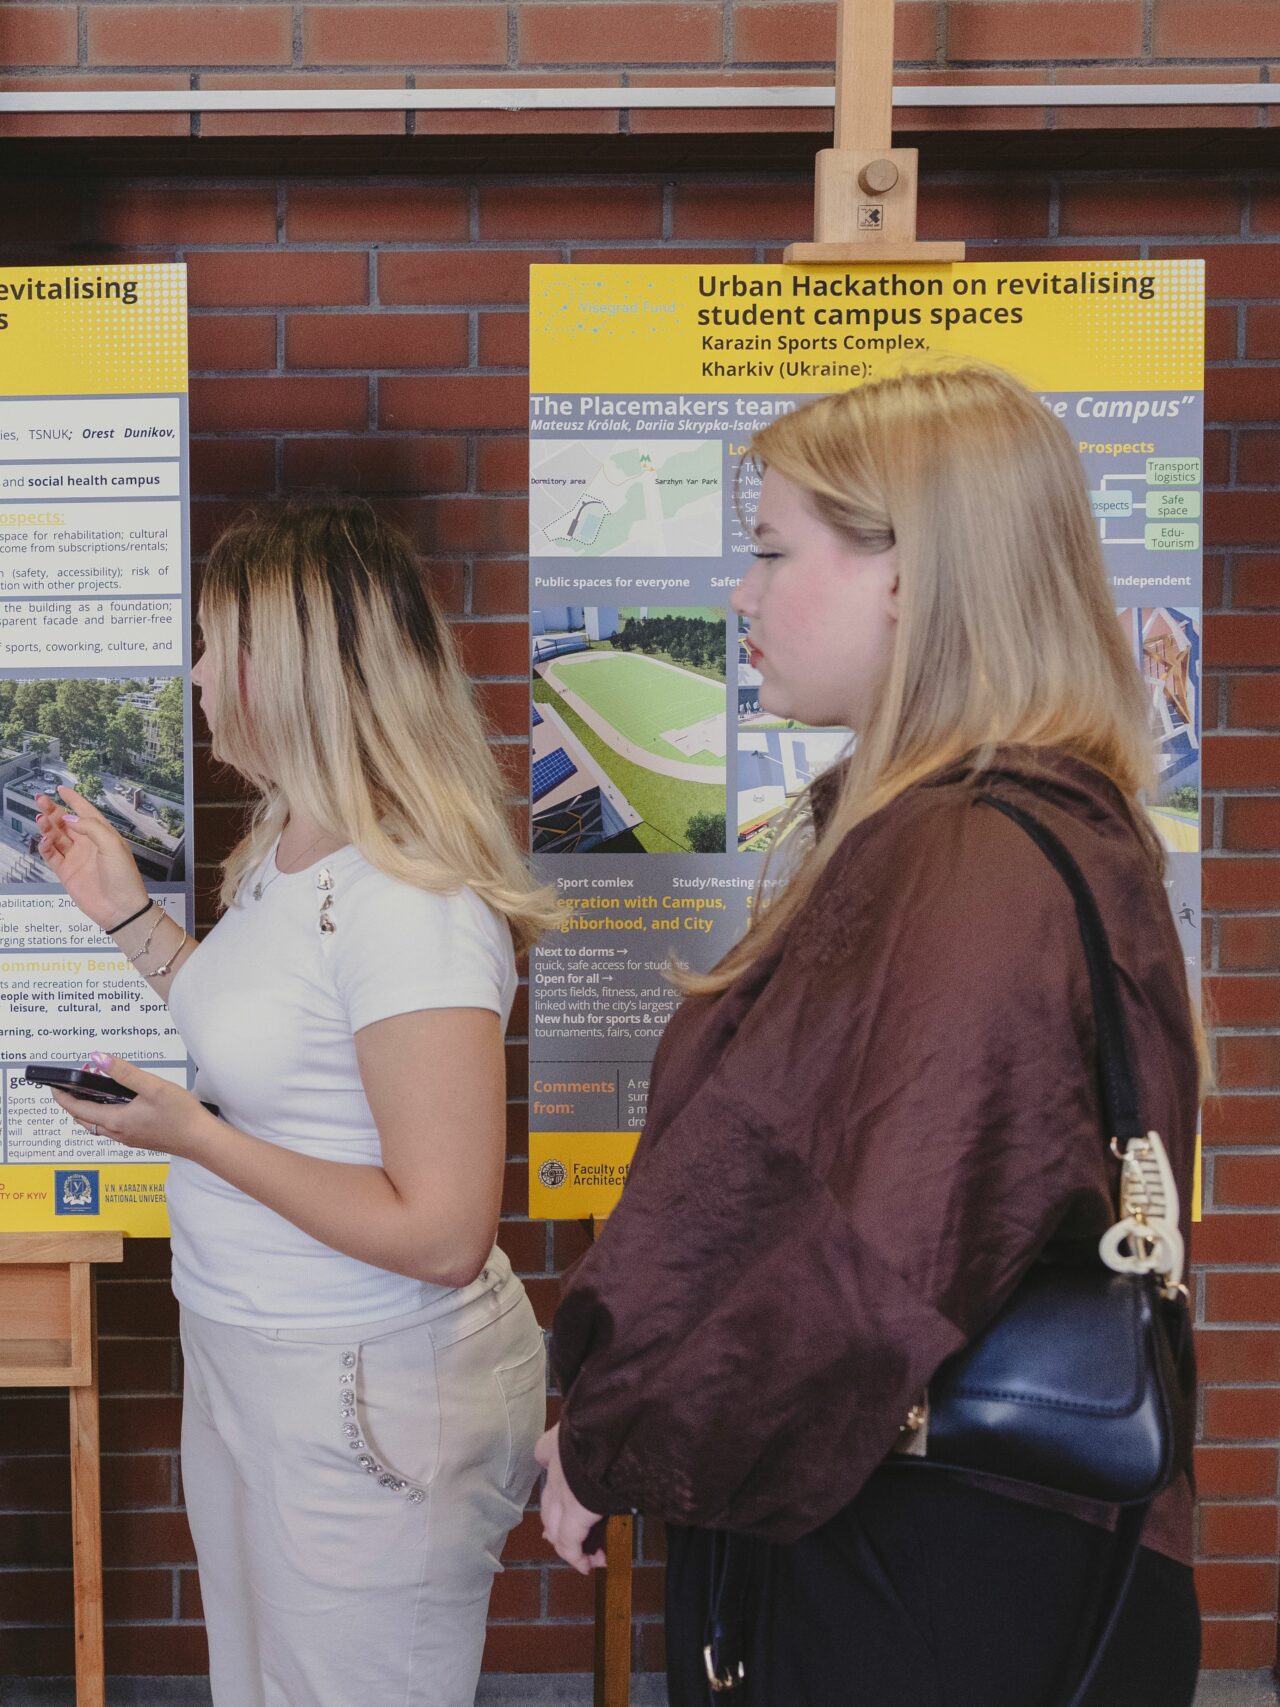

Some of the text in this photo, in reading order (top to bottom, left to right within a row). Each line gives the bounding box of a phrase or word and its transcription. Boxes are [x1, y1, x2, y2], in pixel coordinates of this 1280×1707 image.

[699, 270, 1158, 299] Urban Hackathon on revitalising
[698, 303, 1022, 329] student campus spaces
[702, 334, 929, 354] Karazin Sports Complex,
[702, 360, 872, 379] Kharkiv (Ukraine):
[528, 395, 798, 418] The Placemakers team
[1076, 395, 1194, 423] Campus”
[528, 418, 584, 434] Mateusz
[587, 419, 632, 431] Królak,
[636, 419, 674, 430] Dariia
[28, 429, 72, 441] TSNUK;
[82, 428, 114, 438] Orest
[124, 426, 174, 438] Dunikov,
[1079, 441, 1155, 457] Prospects
[1148, 461, 1199, 474] Transport
[2, 476, 24, 487] and
[28, 475, 63, 486] social
[67, 474, 107, 485] health
[111, 476, 160, 487] campus
[531, 478, 566, 486] Dormitory
[1154, 471, 1196, 483] logistics
[1162, 494, 1184, 506] Safe
[1158, 507, 1188, 518] space
[1161, 527, 1185, 538] Edu-
[1151, 537, 1195, 548] Tourism
[535, 576, 690, 589] Public spaces for everyone
[1114, 575, 1191, 587] Independent
[557, 877, 633, 890] Sport comlex
[624, 896, 726, 912] with Campus,
[651, 917, 713, 933] and City
[535, 946, 614, 957] Next to dorms
[535, 973, 599, 986] Open for all
[533, 1080, 615, 1093] Comments
[533, 1101, 575, 1114] from:
[573, 1163, 629, 1177] Faculty of
[12, 1192, 24, 1200] OF
[27, 1192, 47, 1200] KYIV
